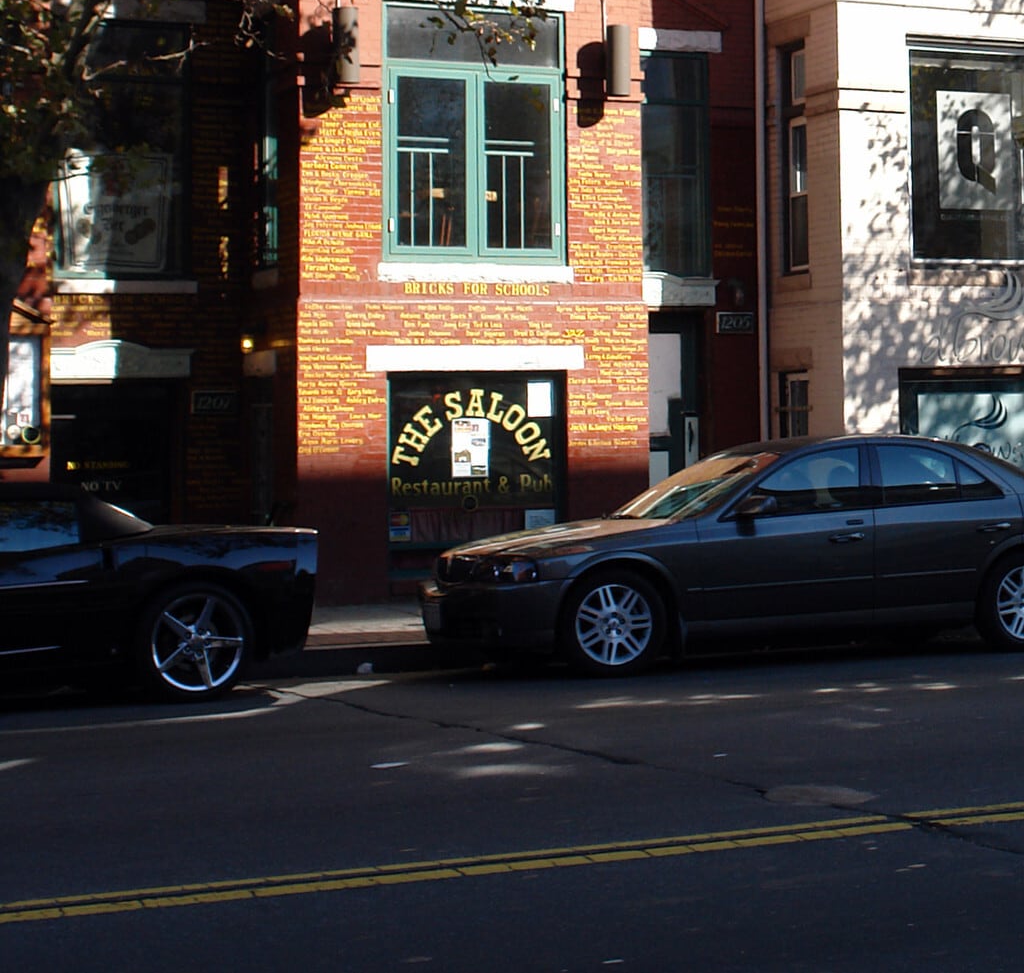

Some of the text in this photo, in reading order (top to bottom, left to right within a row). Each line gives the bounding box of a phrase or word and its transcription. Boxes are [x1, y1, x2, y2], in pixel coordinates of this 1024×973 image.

[956, 108, 997, 195] Q
[403, 282, 550, 296] BRICKS FOR SCHOOLS
[720, 315, 752, 330] 1205
[391, 405, 444, 467] THE
[444, 388, 552, 462] SALOON
[80, 480, 123, 492] NO TV
[391, 477, 491, 496] Restaurant
[499, 475, 511, 495] &
